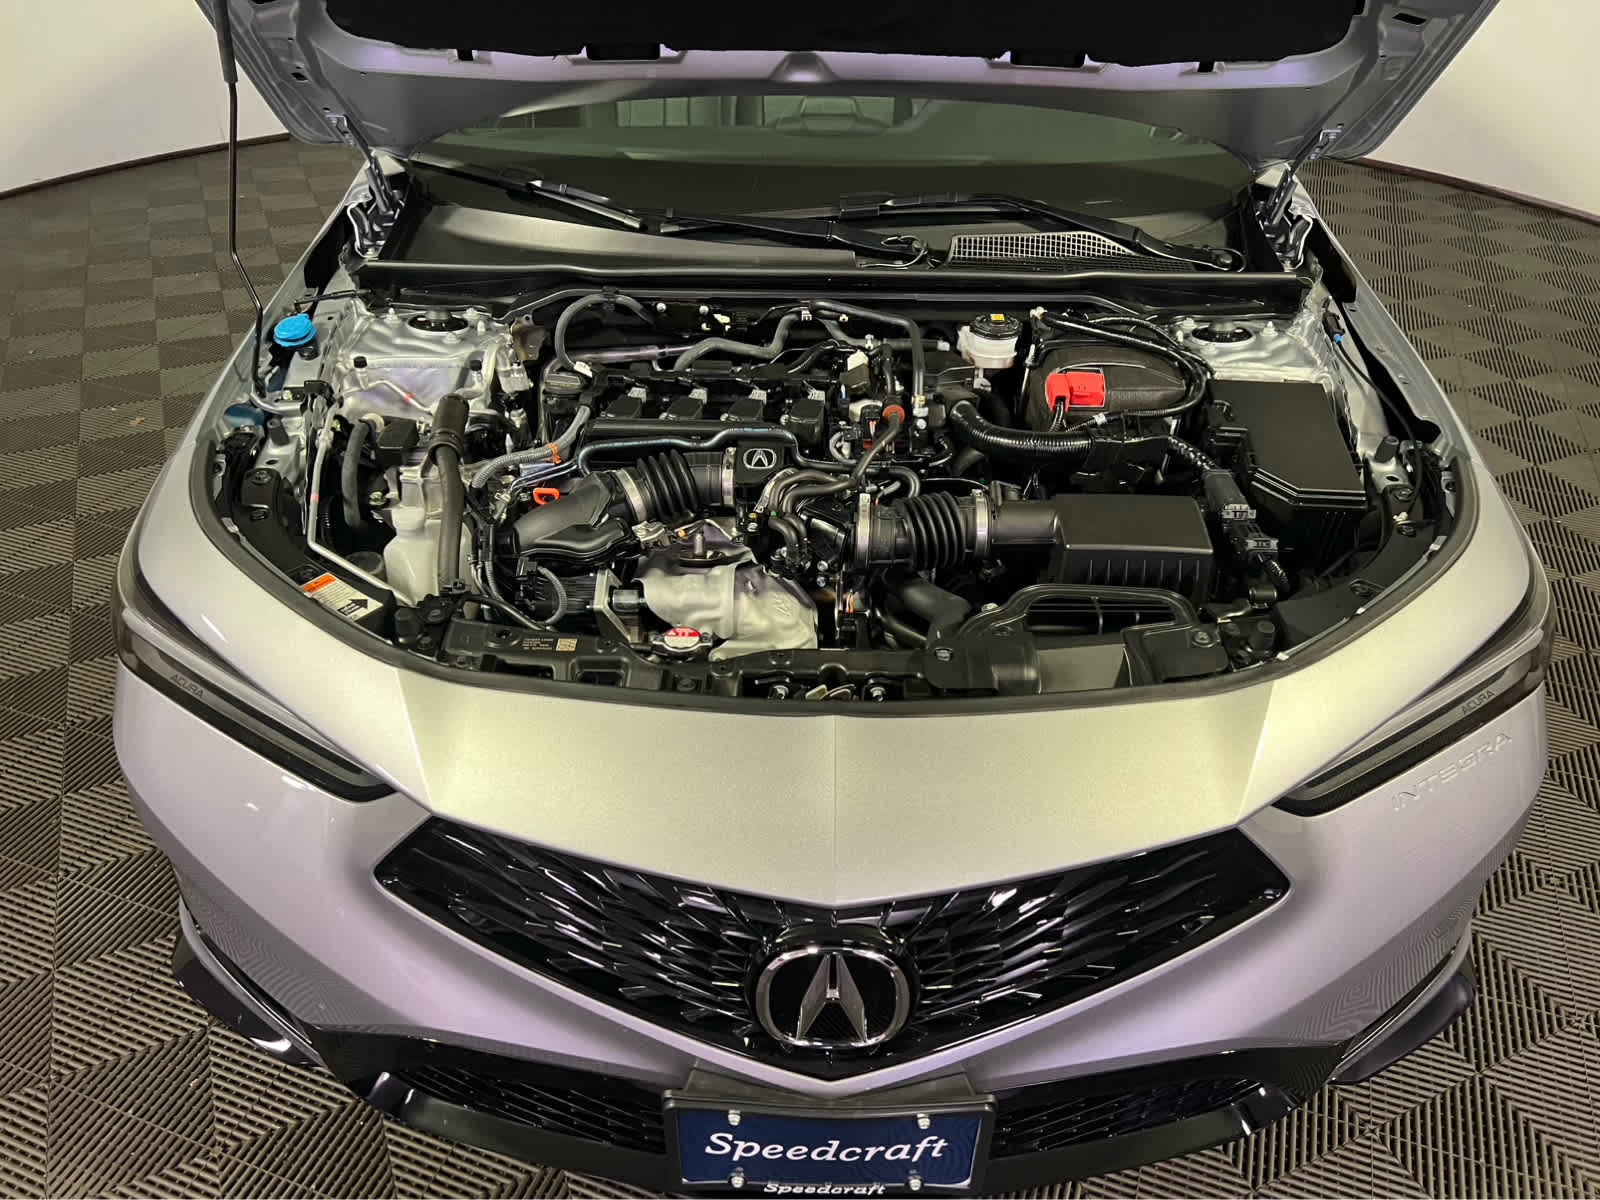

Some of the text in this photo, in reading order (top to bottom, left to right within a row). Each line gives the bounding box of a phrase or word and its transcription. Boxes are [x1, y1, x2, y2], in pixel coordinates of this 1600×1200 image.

[169, 674, 204, 698] ACURA
[1461, 689, 1496, 715] ACURA
[1392, 732, 1512, 811] INTEGRA
[705, 1132, 948, 1161] Speedcraft
[763, 1183, 886, 1195] Speedcraft
